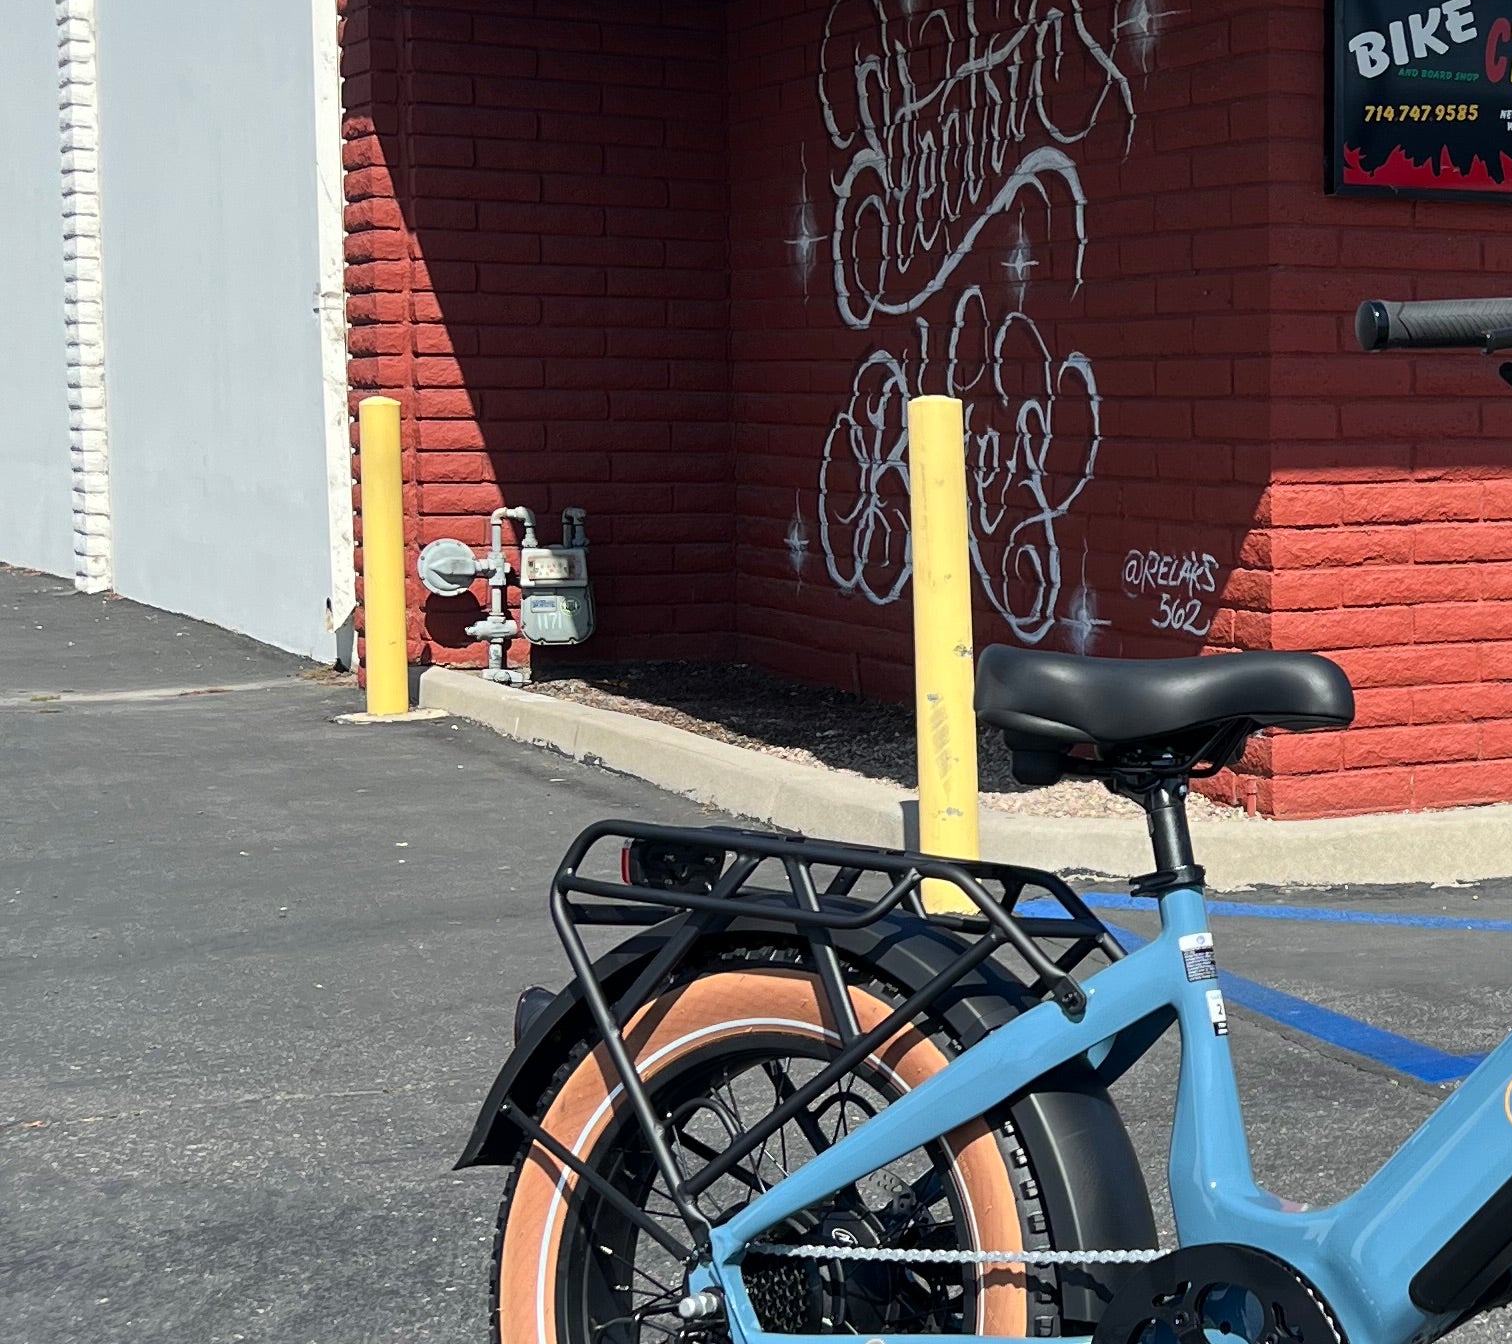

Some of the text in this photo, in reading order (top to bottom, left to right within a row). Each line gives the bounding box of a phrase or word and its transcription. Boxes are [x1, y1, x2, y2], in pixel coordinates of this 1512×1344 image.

[1398, 68, 1479, 82] AND BOARD SHOP
[1364, 104, 1479, 123] 714.747.9585
[1152, 593, 1211, 636] 562
